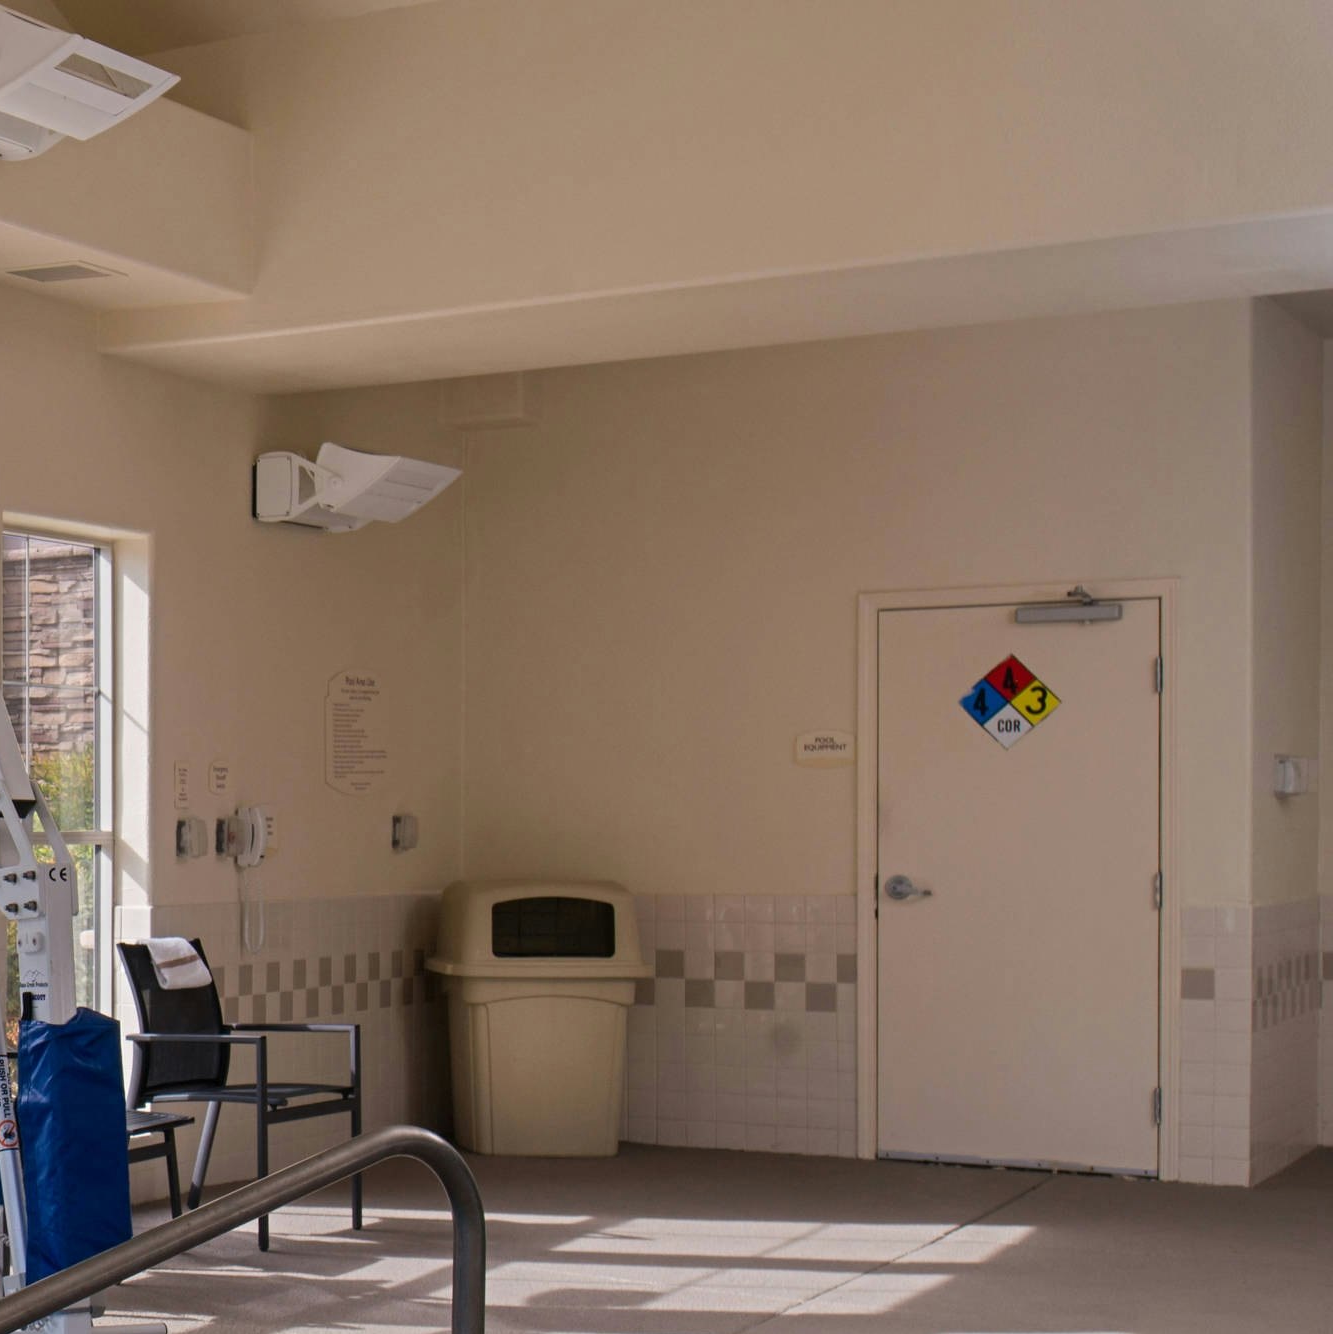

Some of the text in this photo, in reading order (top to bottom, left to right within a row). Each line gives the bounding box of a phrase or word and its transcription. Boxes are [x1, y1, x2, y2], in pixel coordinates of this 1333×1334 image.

[1002, 666, 1019, 696] 4
[973, 686, 1048, 717] 4 3
[997, 719, 1022, 733] COR
[48, 867, 68, 881] CE
[0, 1083, 9, 1096] OR
[3, 1097, 12, 1119] PULL
